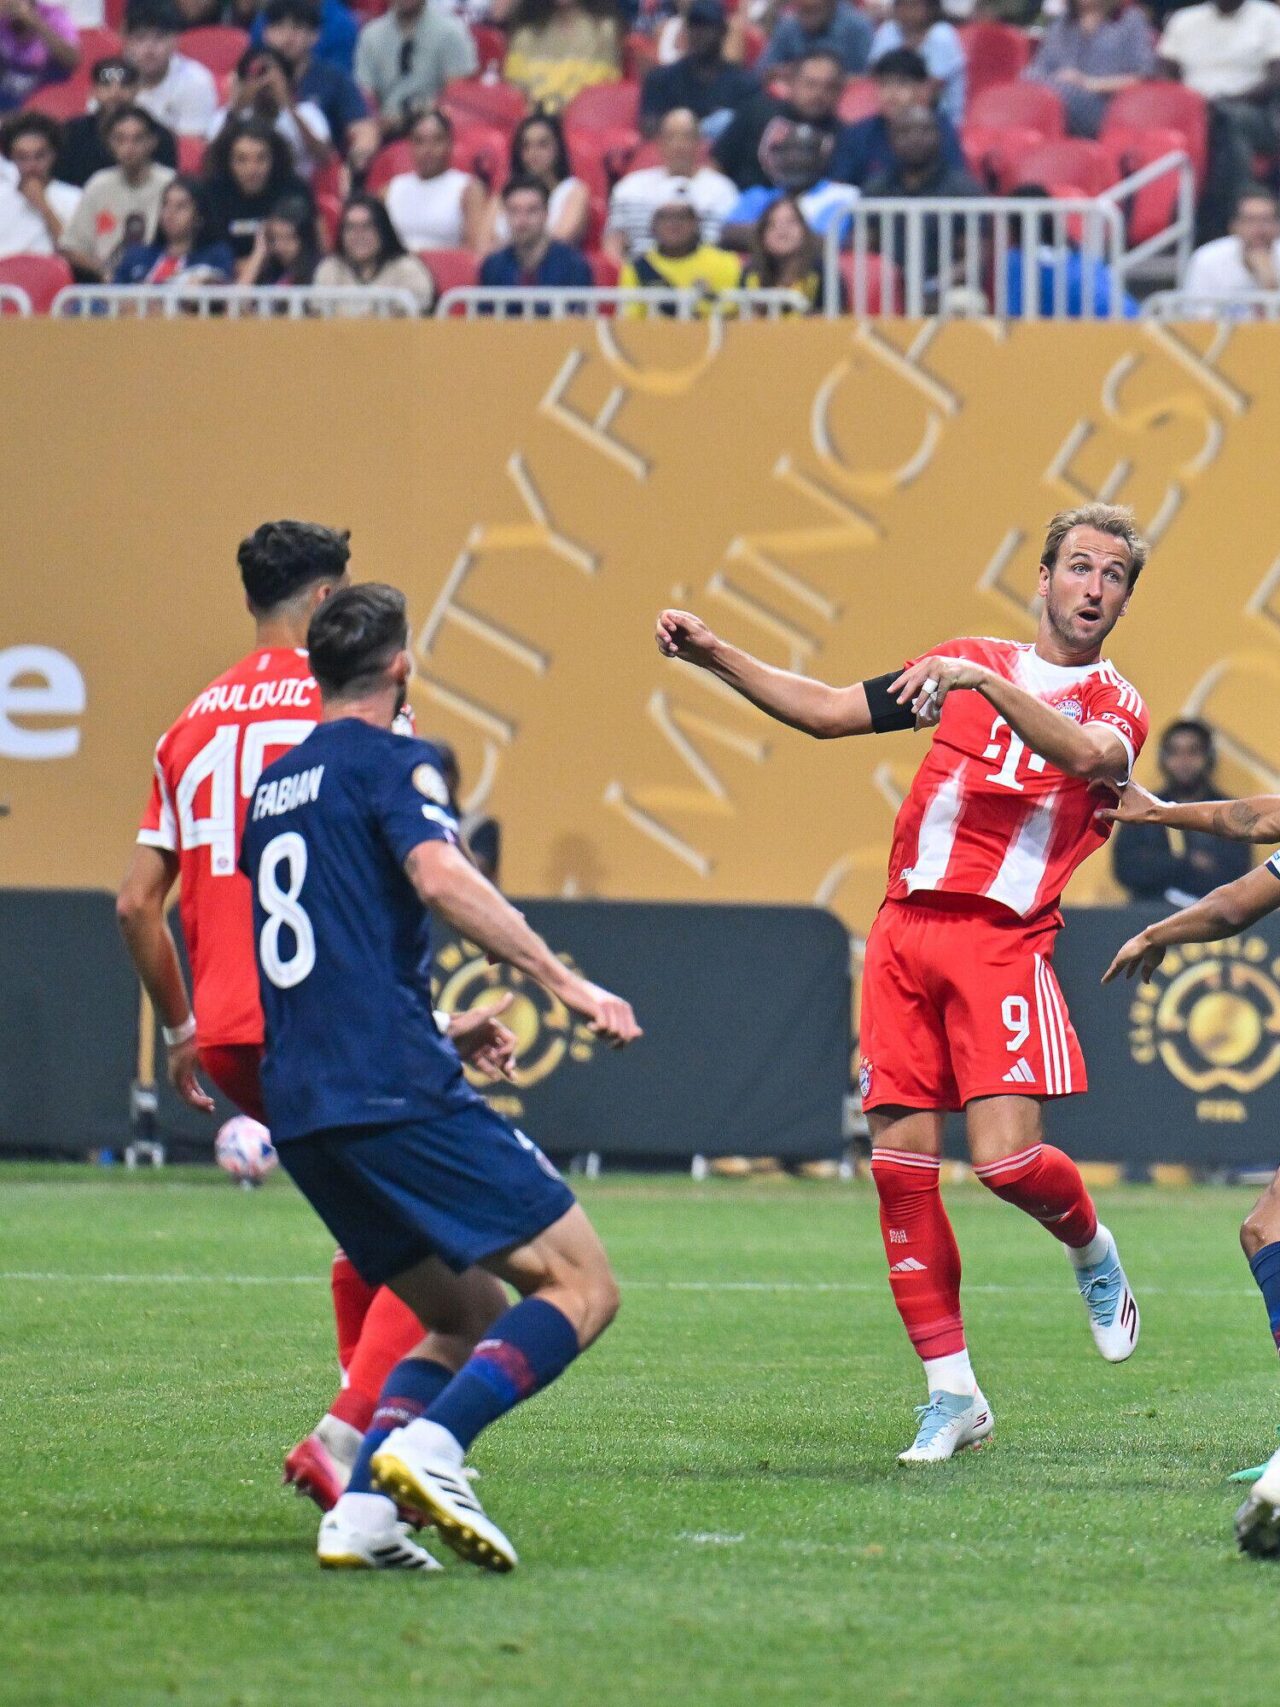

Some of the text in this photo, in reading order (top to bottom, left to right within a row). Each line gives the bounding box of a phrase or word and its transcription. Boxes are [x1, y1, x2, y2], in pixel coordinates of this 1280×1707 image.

[251, 764, 326, 823] FABIAN
[257, 831, 317, 990] 8
[1001, 995, 1031, 1052] 9
